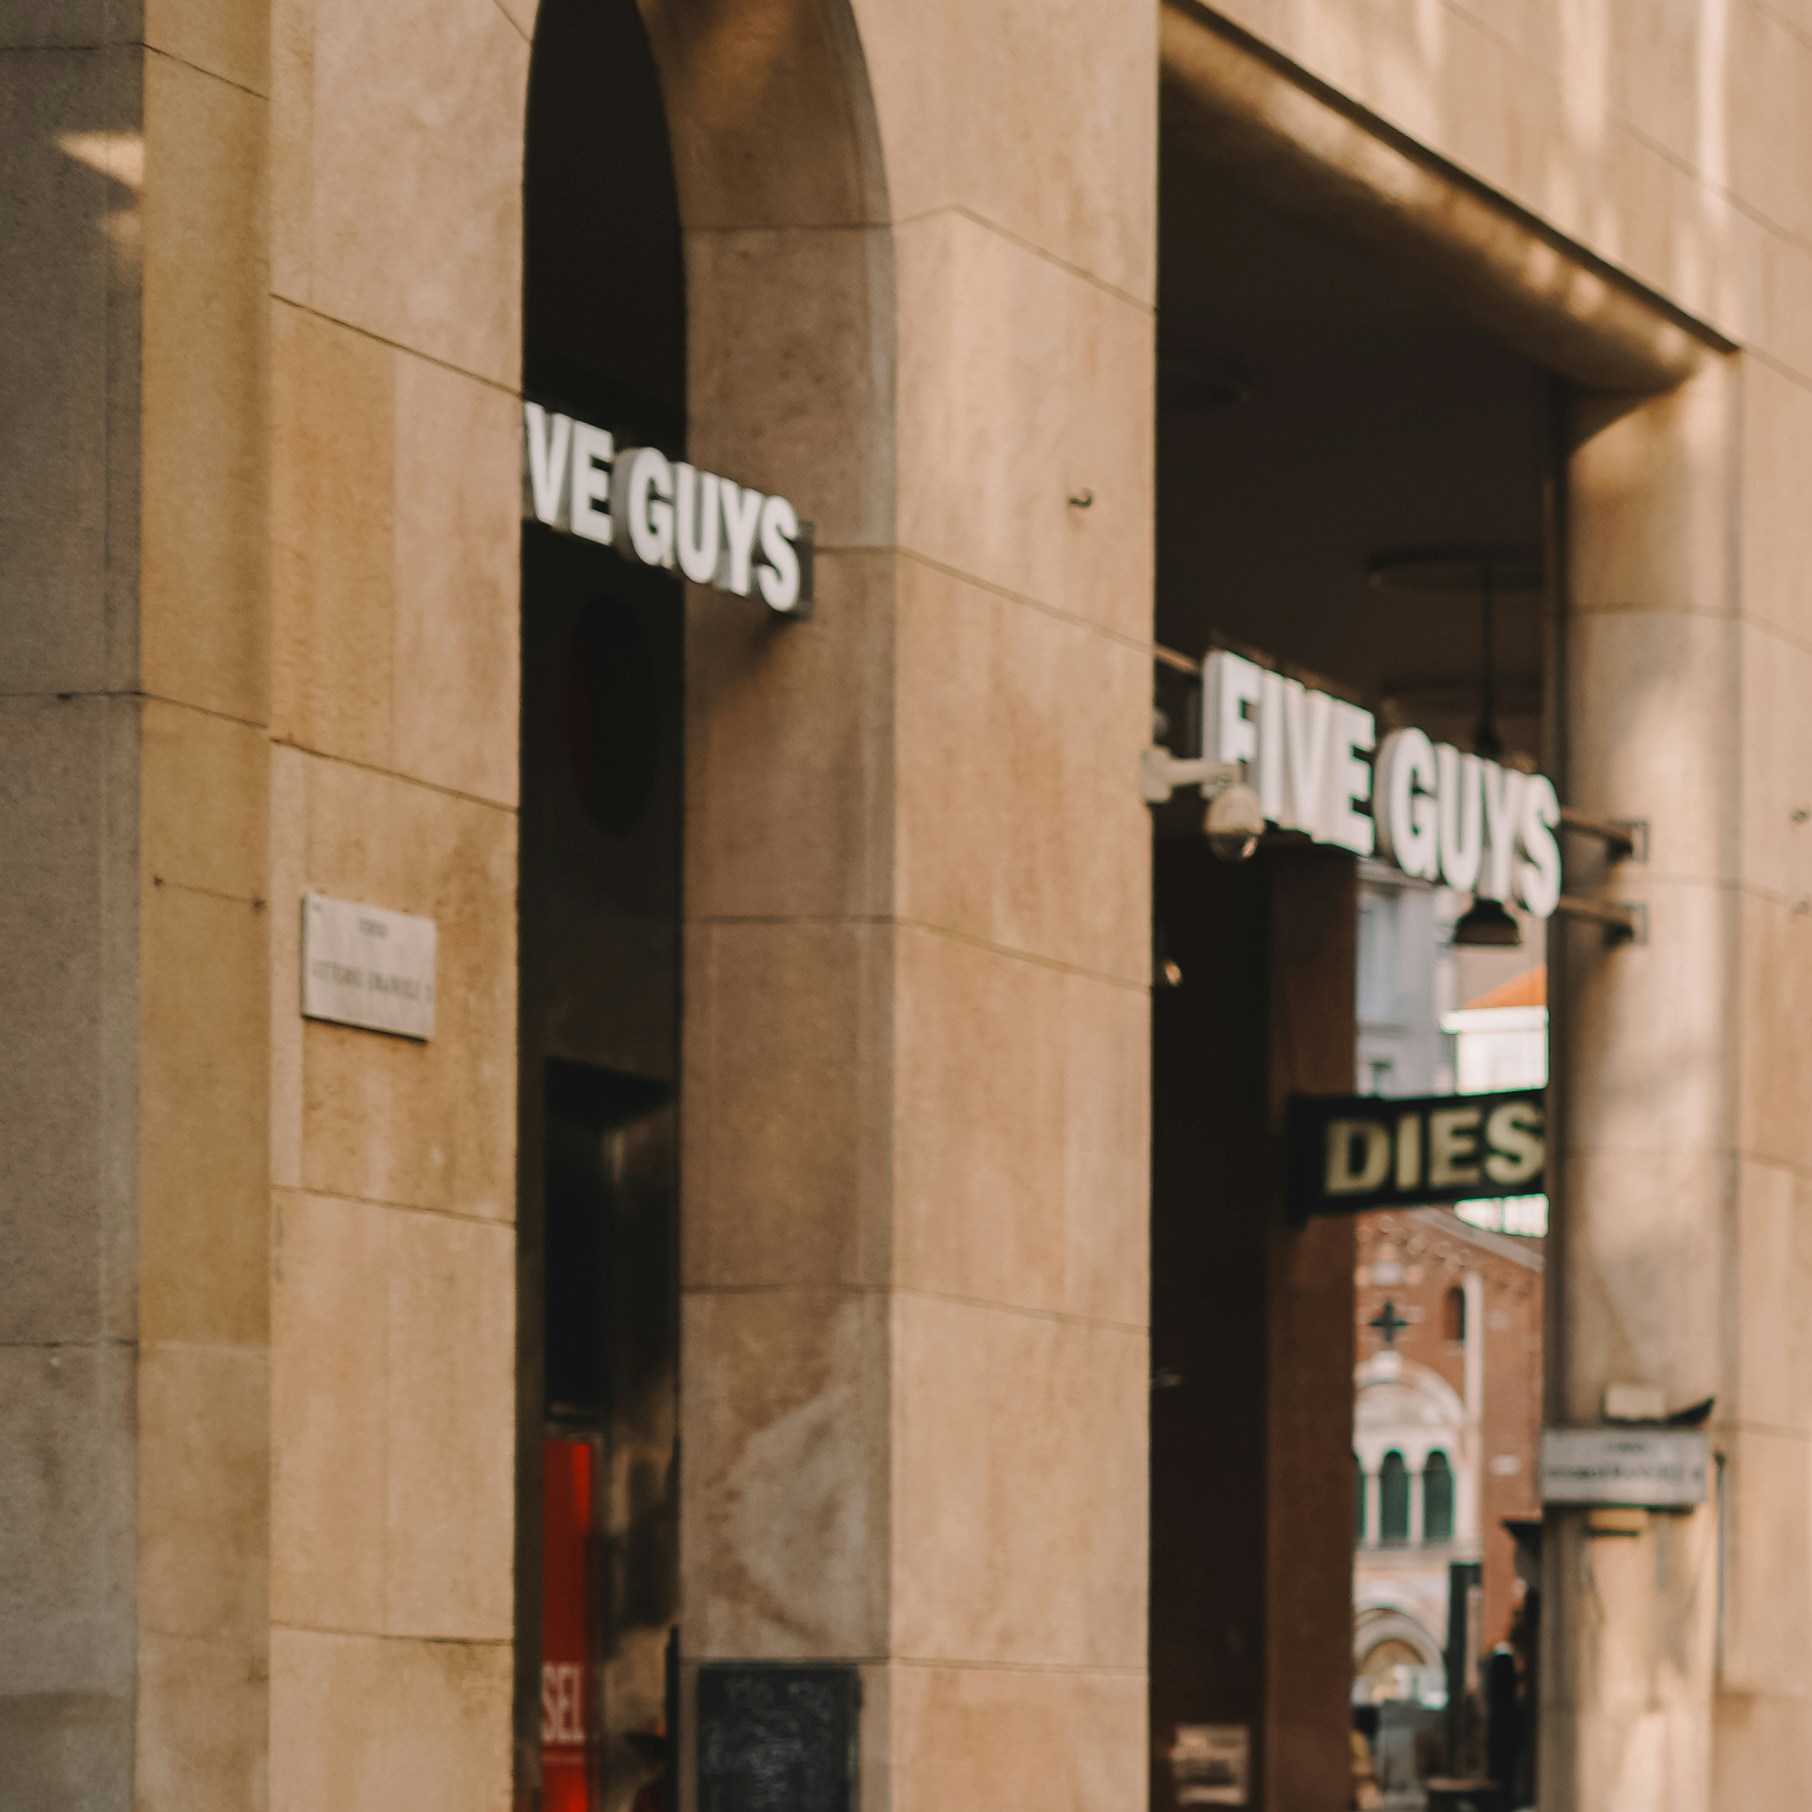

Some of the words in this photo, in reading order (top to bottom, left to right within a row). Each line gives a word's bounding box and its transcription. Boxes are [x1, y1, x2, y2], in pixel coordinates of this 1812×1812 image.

[624, 446, 800, 613] GUYS
[1204, 650, 1375, 857] FIVE
[1380, 727, 1562, 919] GUYS
[1325, 1102, 1544, 1197] DIES
